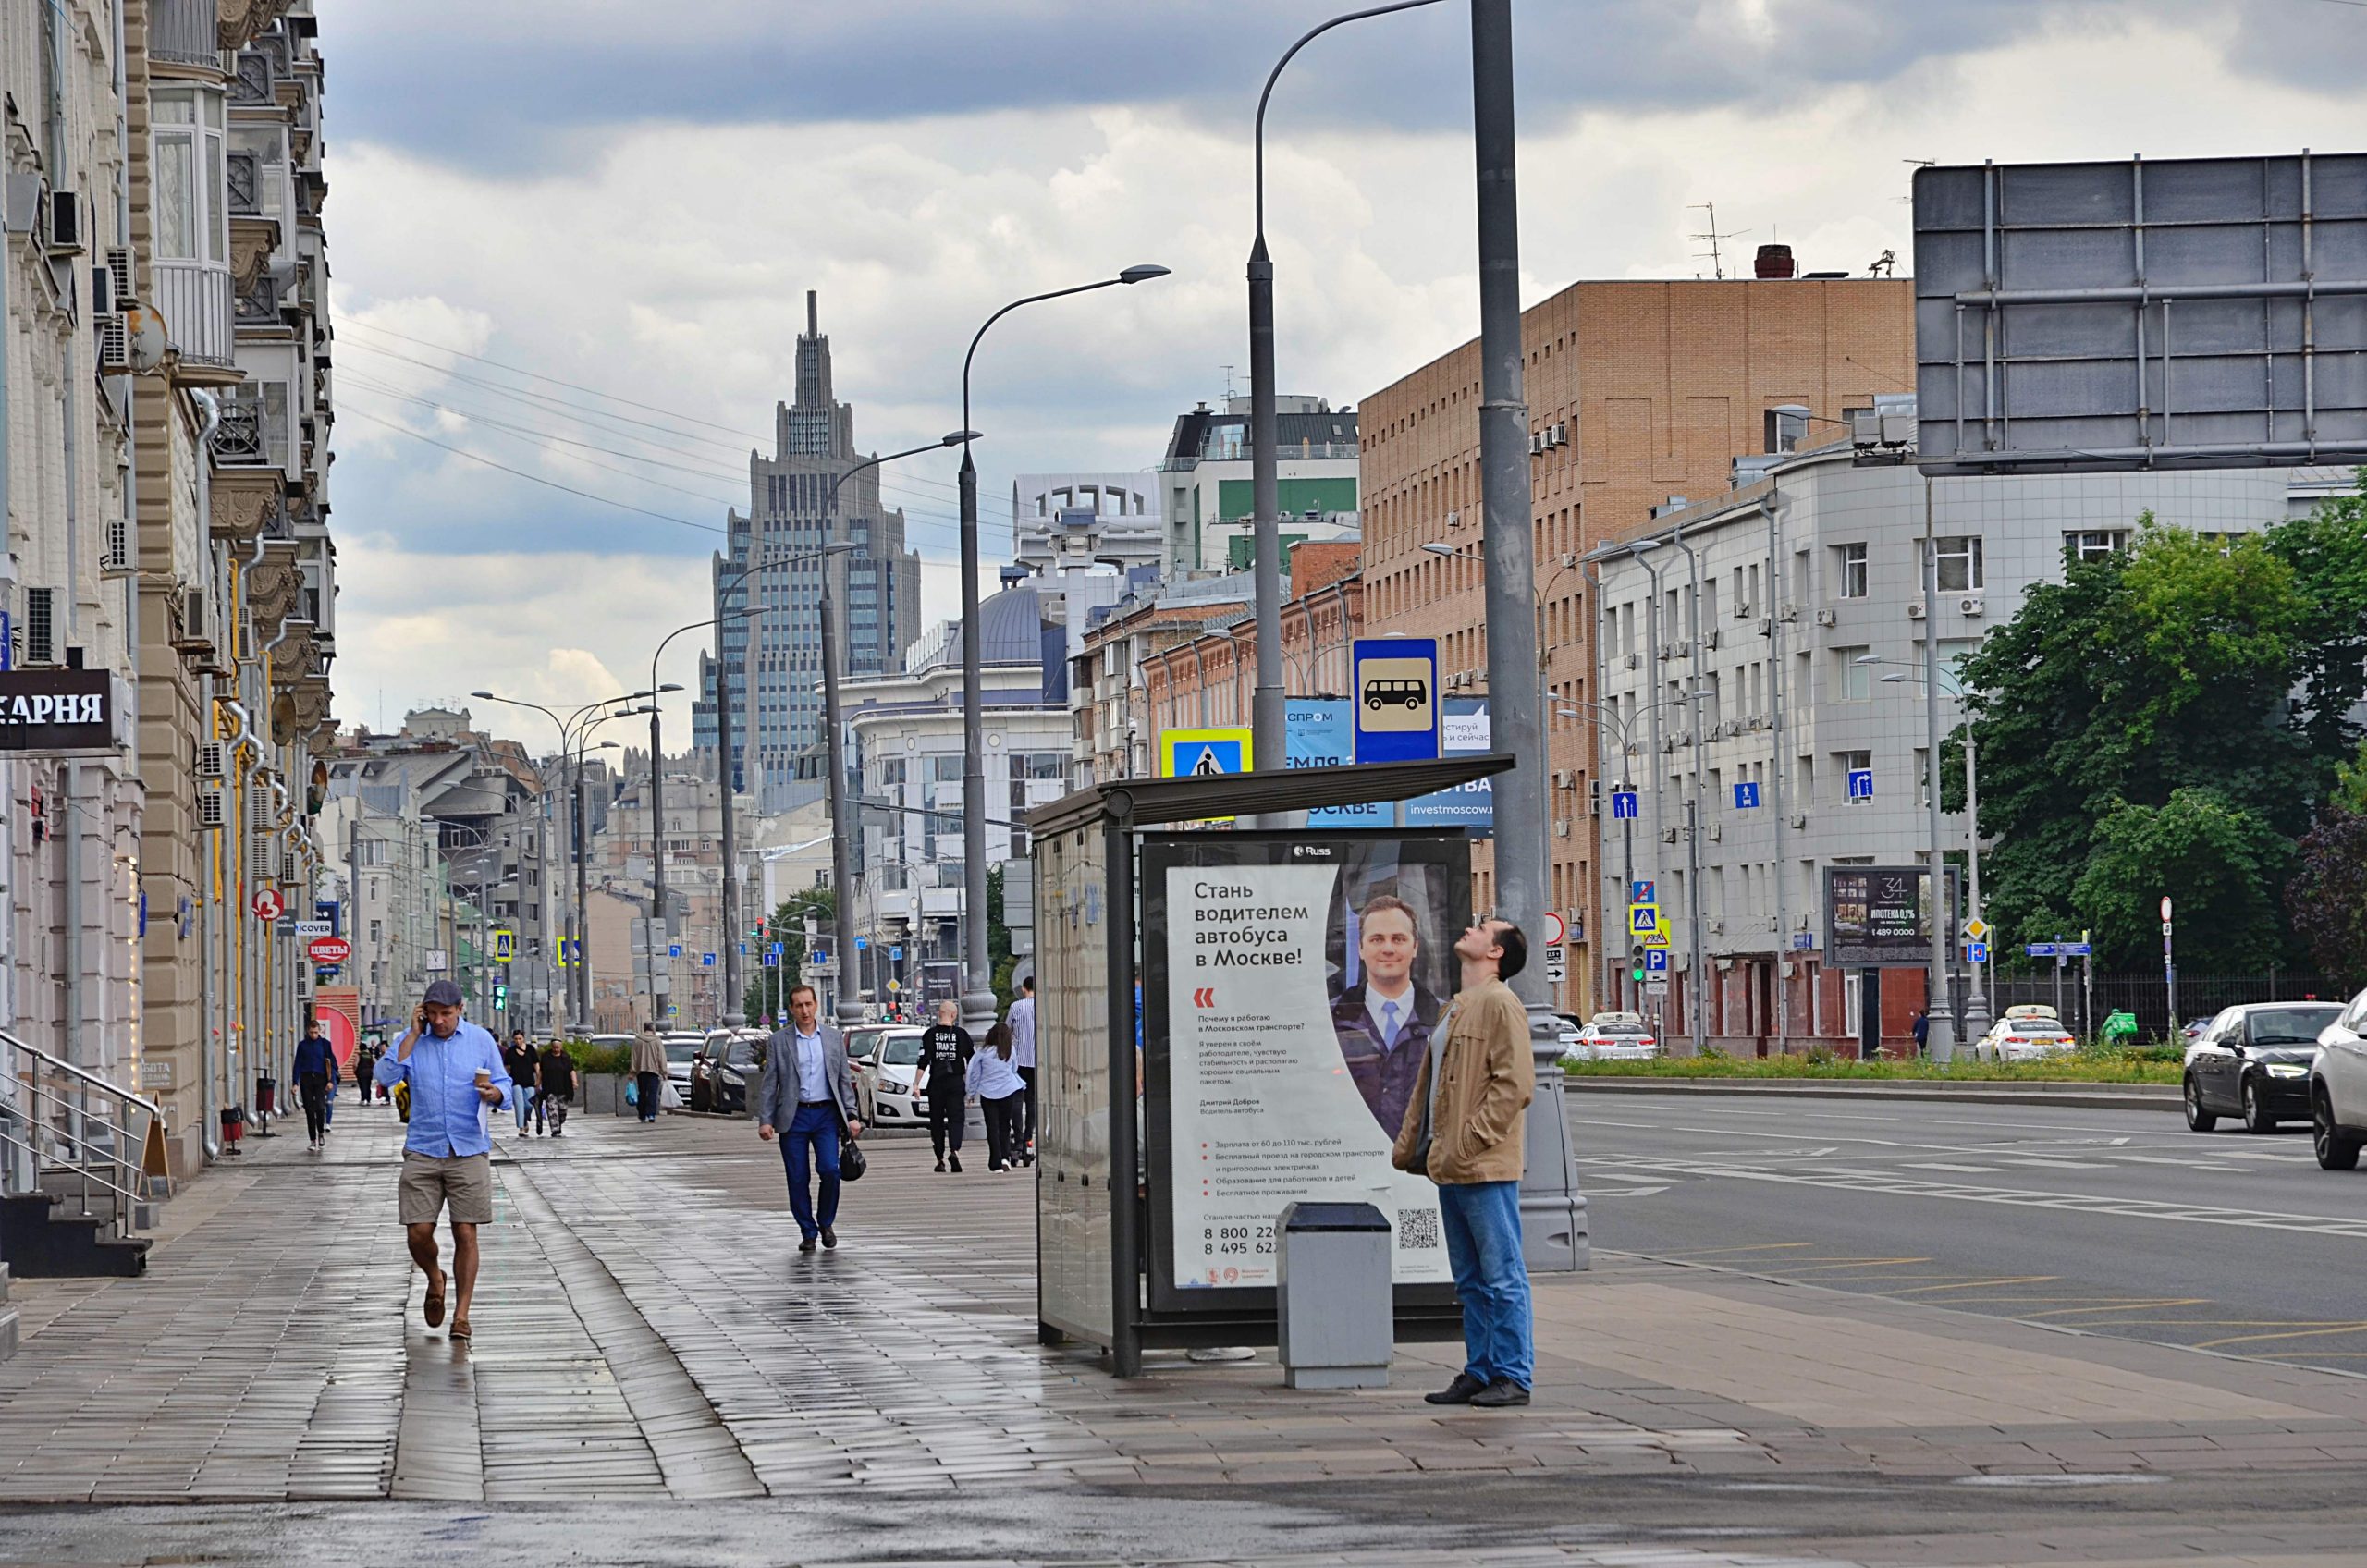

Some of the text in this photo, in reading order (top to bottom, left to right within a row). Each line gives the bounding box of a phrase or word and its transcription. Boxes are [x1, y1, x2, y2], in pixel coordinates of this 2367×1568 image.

[1286, 713, 1333, 722] СПРОМ
[1195, 882, 1253, 899] Стань
[1195, 907, 1309, 924] водителем
[1870, 909, 1899, 919] ИПОТЕКА
[1195, 925, 1288, 947] автобуса
[1876, 928, 1892, 937] 489
[311, 946, 349, 955] ЦВЕТЫ
[1196, 948, 1302, 967] в Москве!
[1650, 952, 1662, 969] P
[1198, 1015, 1229, 1023] Почему
[1237, 1014, 1270, 1023] работаю
[1257, 1023, 1305, 1032] транспорте?
[1314, 1138, 1342, 1146] рублей
[1215, 1152, 1260, 1160] Бесплатный
[1282, 1174, 1327, 1182] работников
[1334, 1174, 1356, 1182] детей
[1204, 1226, 1276, 1239] 8 800 22
[1204, 1243, 1213, 1255] 8
[1220, 1243, 1247, 1255] 495
